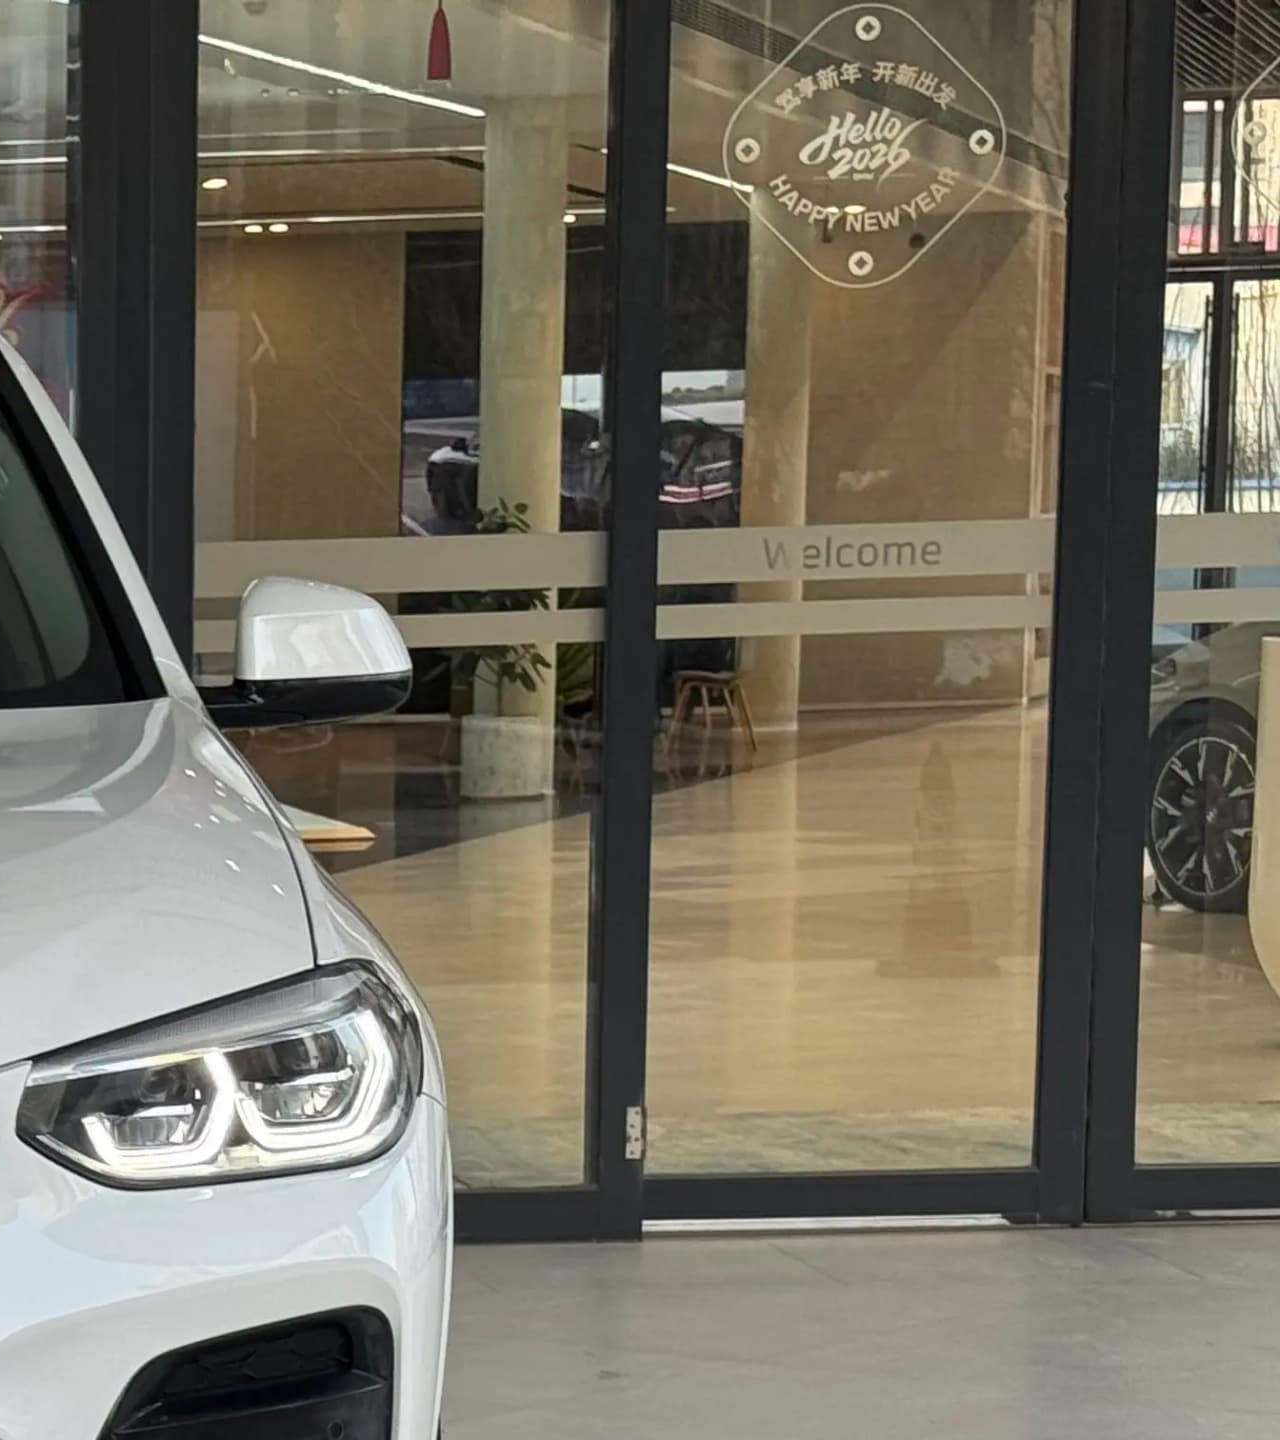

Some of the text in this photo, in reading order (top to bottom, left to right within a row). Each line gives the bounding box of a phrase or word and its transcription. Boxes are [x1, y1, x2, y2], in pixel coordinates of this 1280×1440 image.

[872, 60, 957, 111] 开新出发
[799, 106, 902, 165] Hello
[827, 118, 928, 193] 2026
[768, 165, 961, 233] HAPPY NEW YEAR
[762, 536, 943, 571] Welcome
